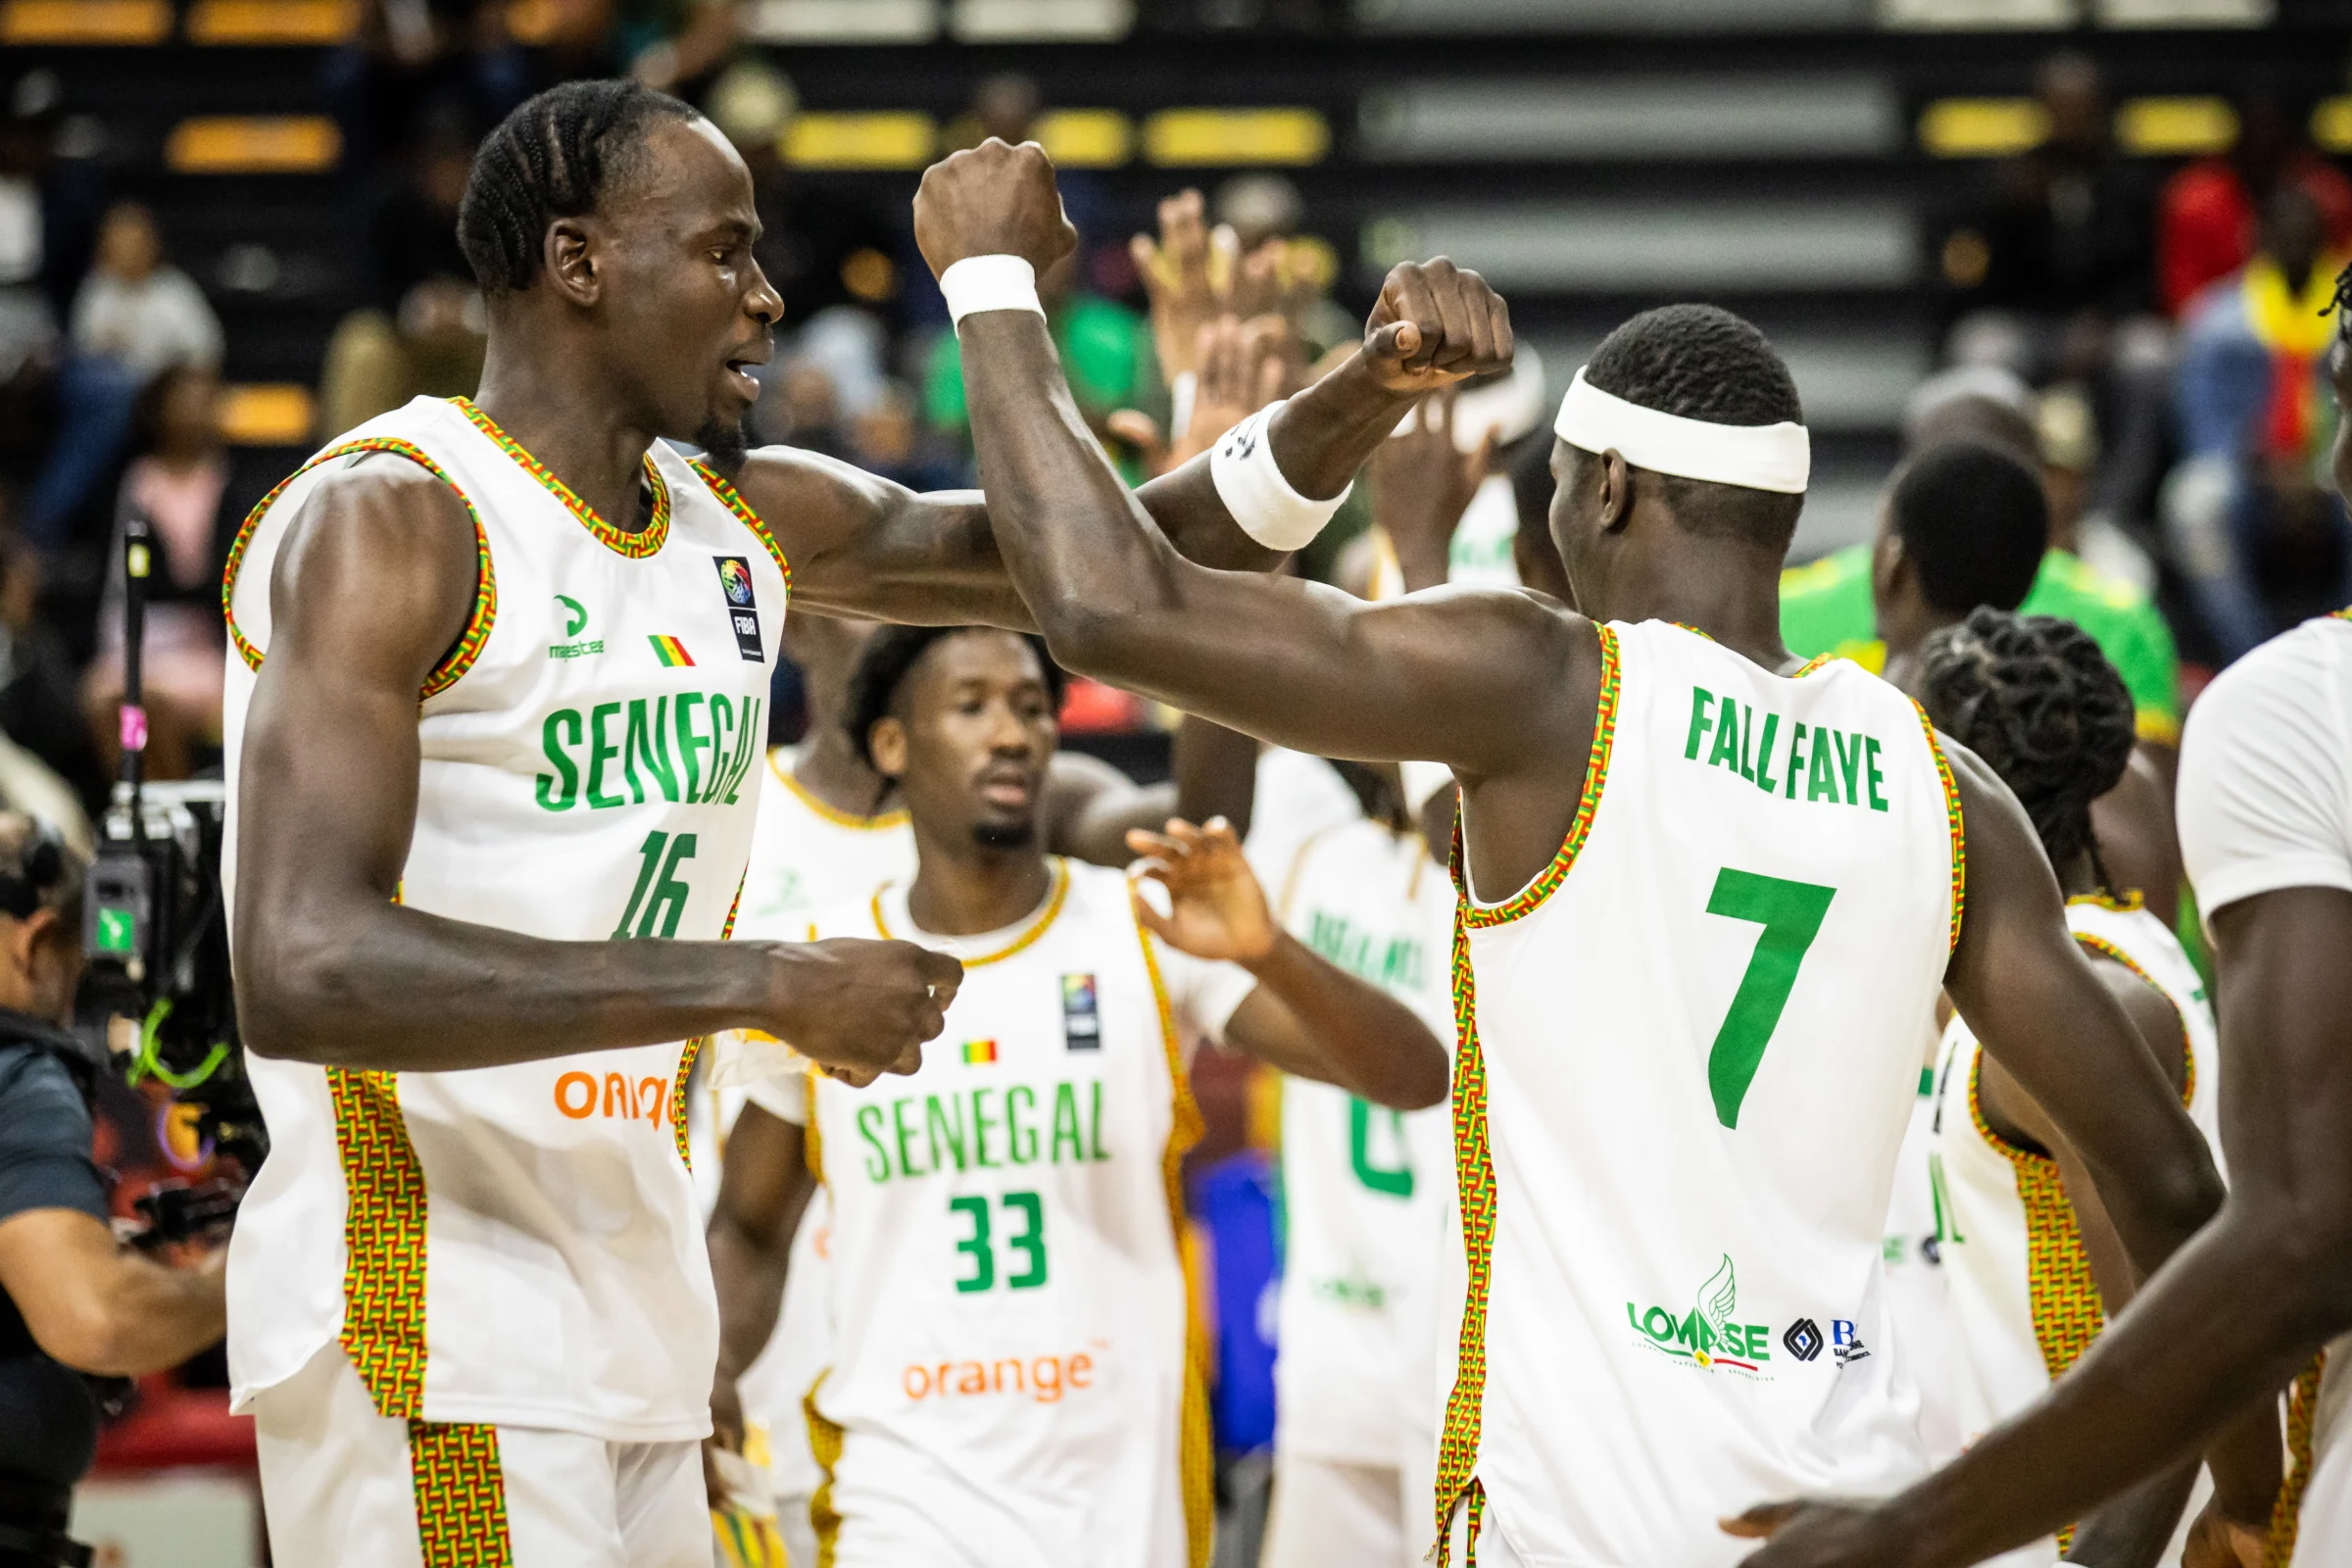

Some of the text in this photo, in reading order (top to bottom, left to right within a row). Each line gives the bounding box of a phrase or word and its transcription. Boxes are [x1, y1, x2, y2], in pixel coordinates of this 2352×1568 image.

[734, 615, 757, 635] FIBA
[535, 691, 761, 812] SENEGAL
[1684, 685, 1889, 812] FALL FAYE
[609, 830, 698, 941] 16
[1704, 866, 1838, 1131] 7
[856, 1080, 1112, 1185] SENEGAL
[949, 1191, 1050, 1295] 33
[903, 1352, 1095, 1403] orange
